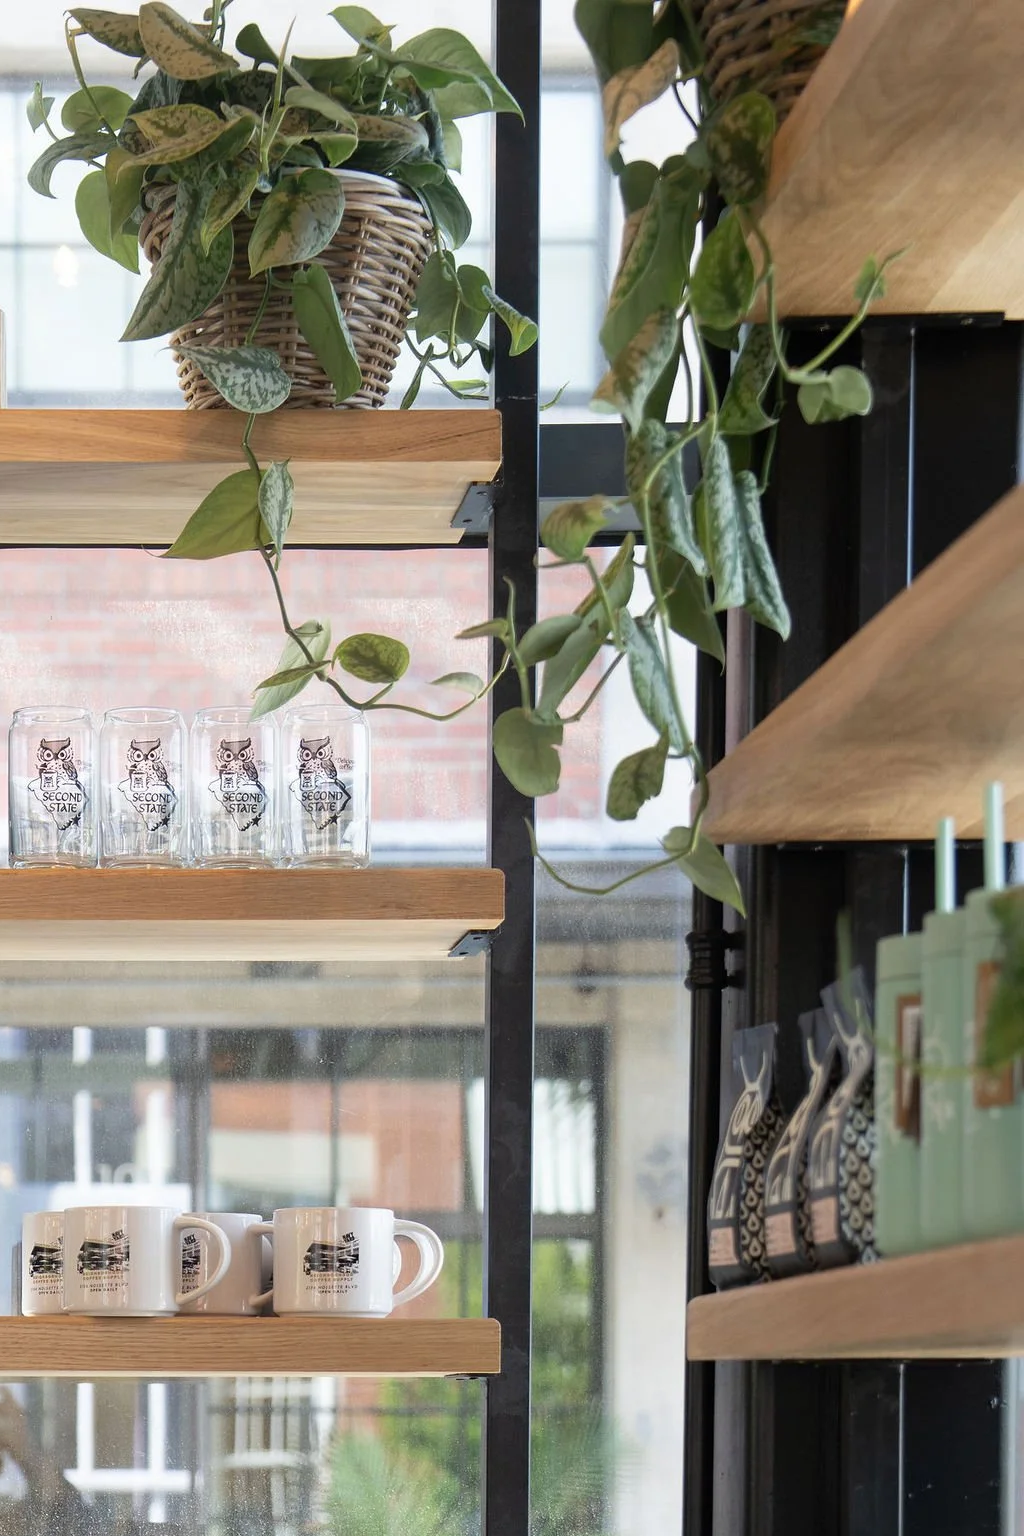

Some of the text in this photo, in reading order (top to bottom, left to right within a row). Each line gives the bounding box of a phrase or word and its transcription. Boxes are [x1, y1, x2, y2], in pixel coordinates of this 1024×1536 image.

[42, 791, 83, 802] SECOND
[132, 791, 173, 802] SECOND
[222, 791, 263, 803] SECOND
[301, 790, 343, 801] SECOND
[49, 803, 78, 812] STATE
[139, 803, 167, 814] STATE
[228, 803, 257, 814] STATE
[307, 801, 336, 812] STATE
